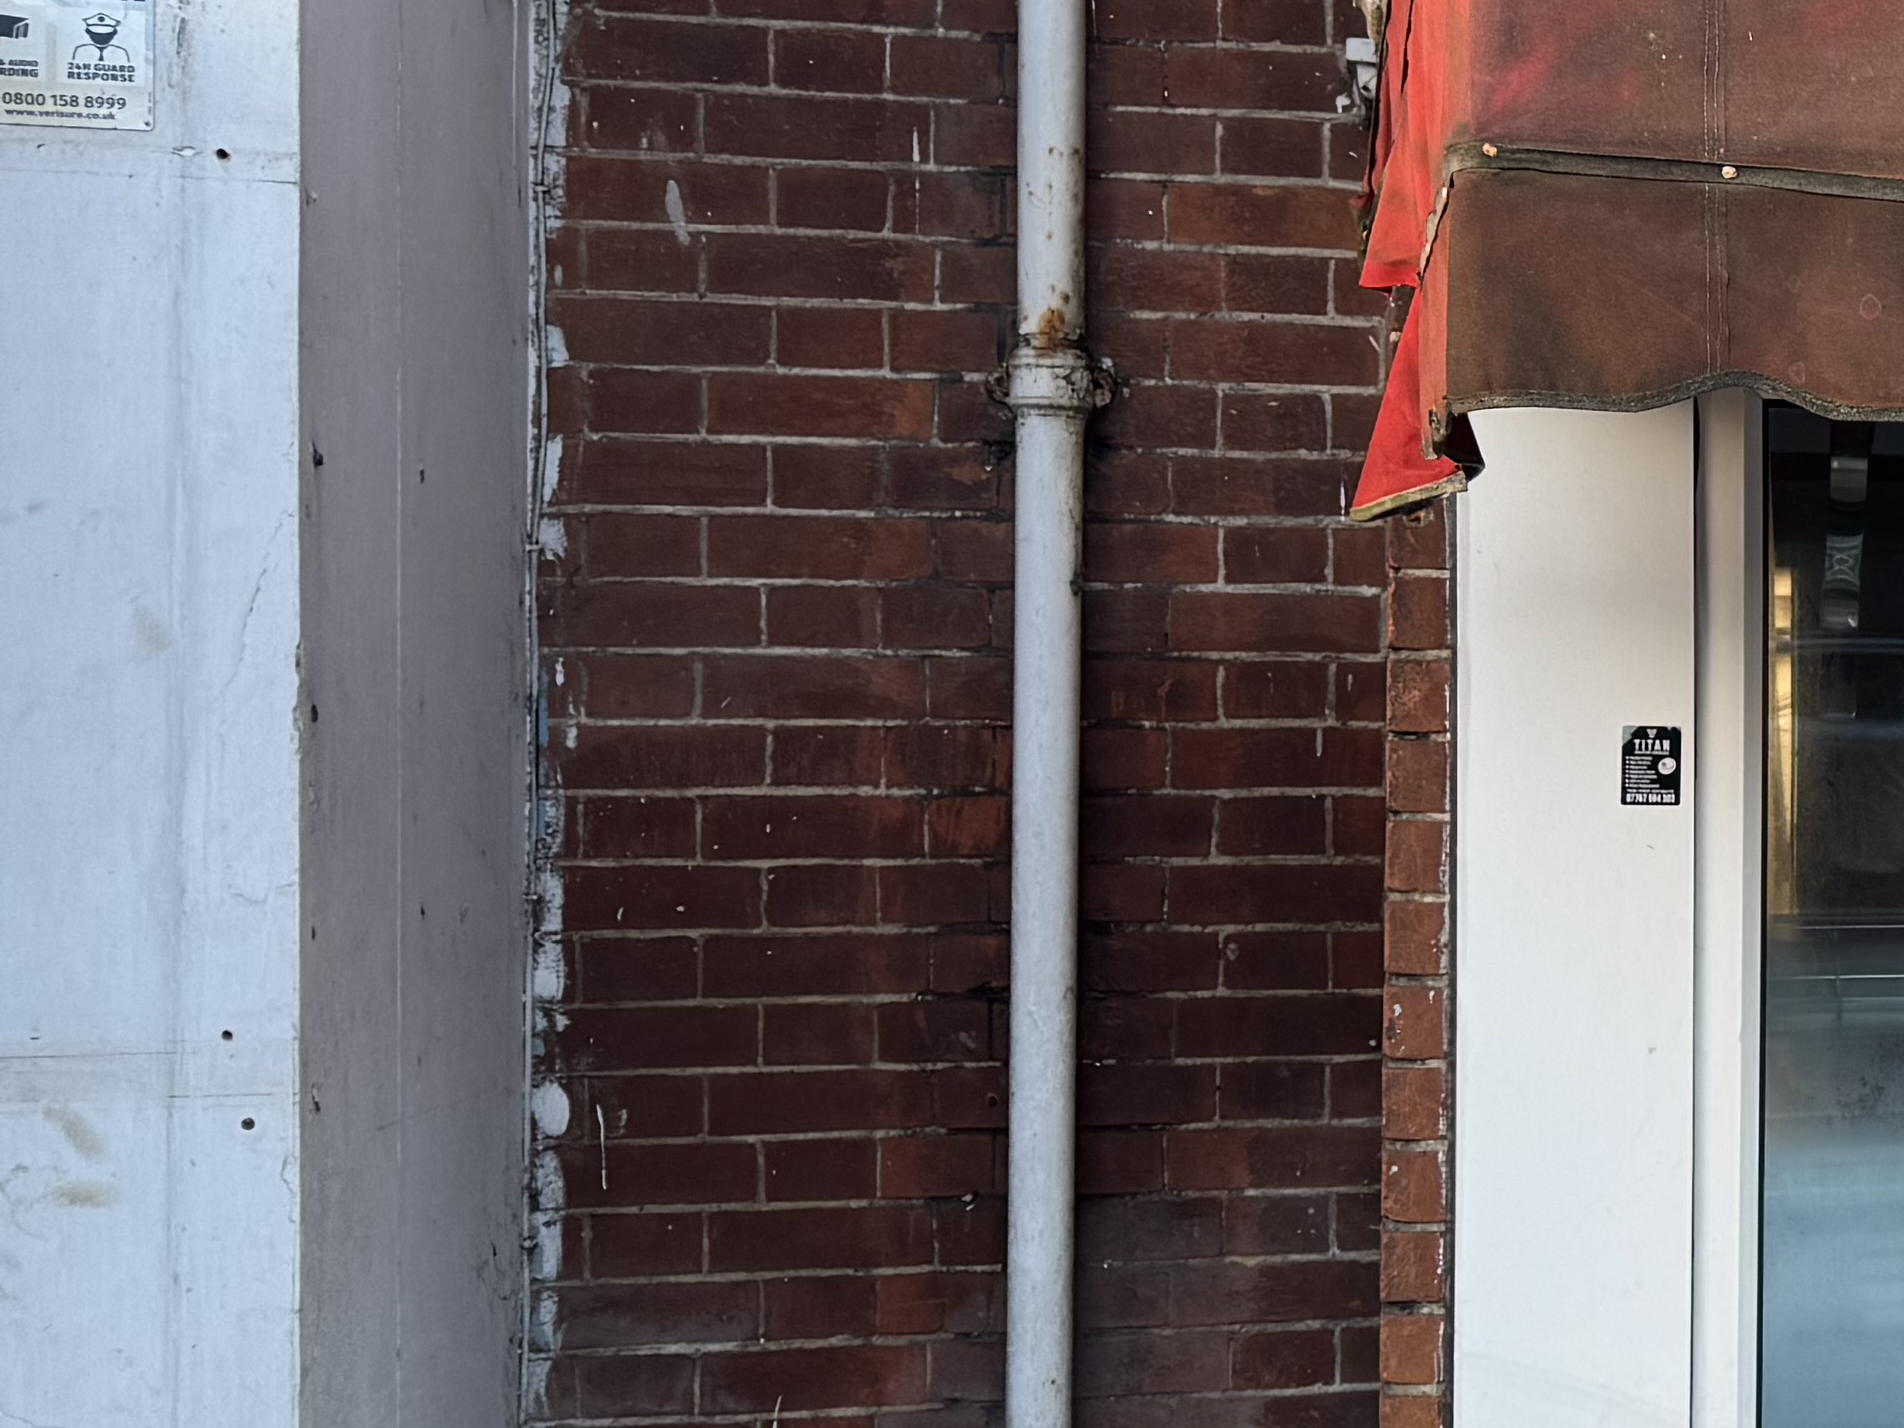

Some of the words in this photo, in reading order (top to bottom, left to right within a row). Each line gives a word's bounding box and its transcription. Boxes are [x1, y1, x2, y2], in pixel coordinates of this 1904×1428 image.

[93, 63, 136, 73] GUARD
[67, 71, 136, 82] RESPONSE
[2, 92, 47, 106] 0800
[50, 94, 80, 108] 158
[84, 95, 127, 110] 8999
[1633, 739, 1671, 751] TITAN
